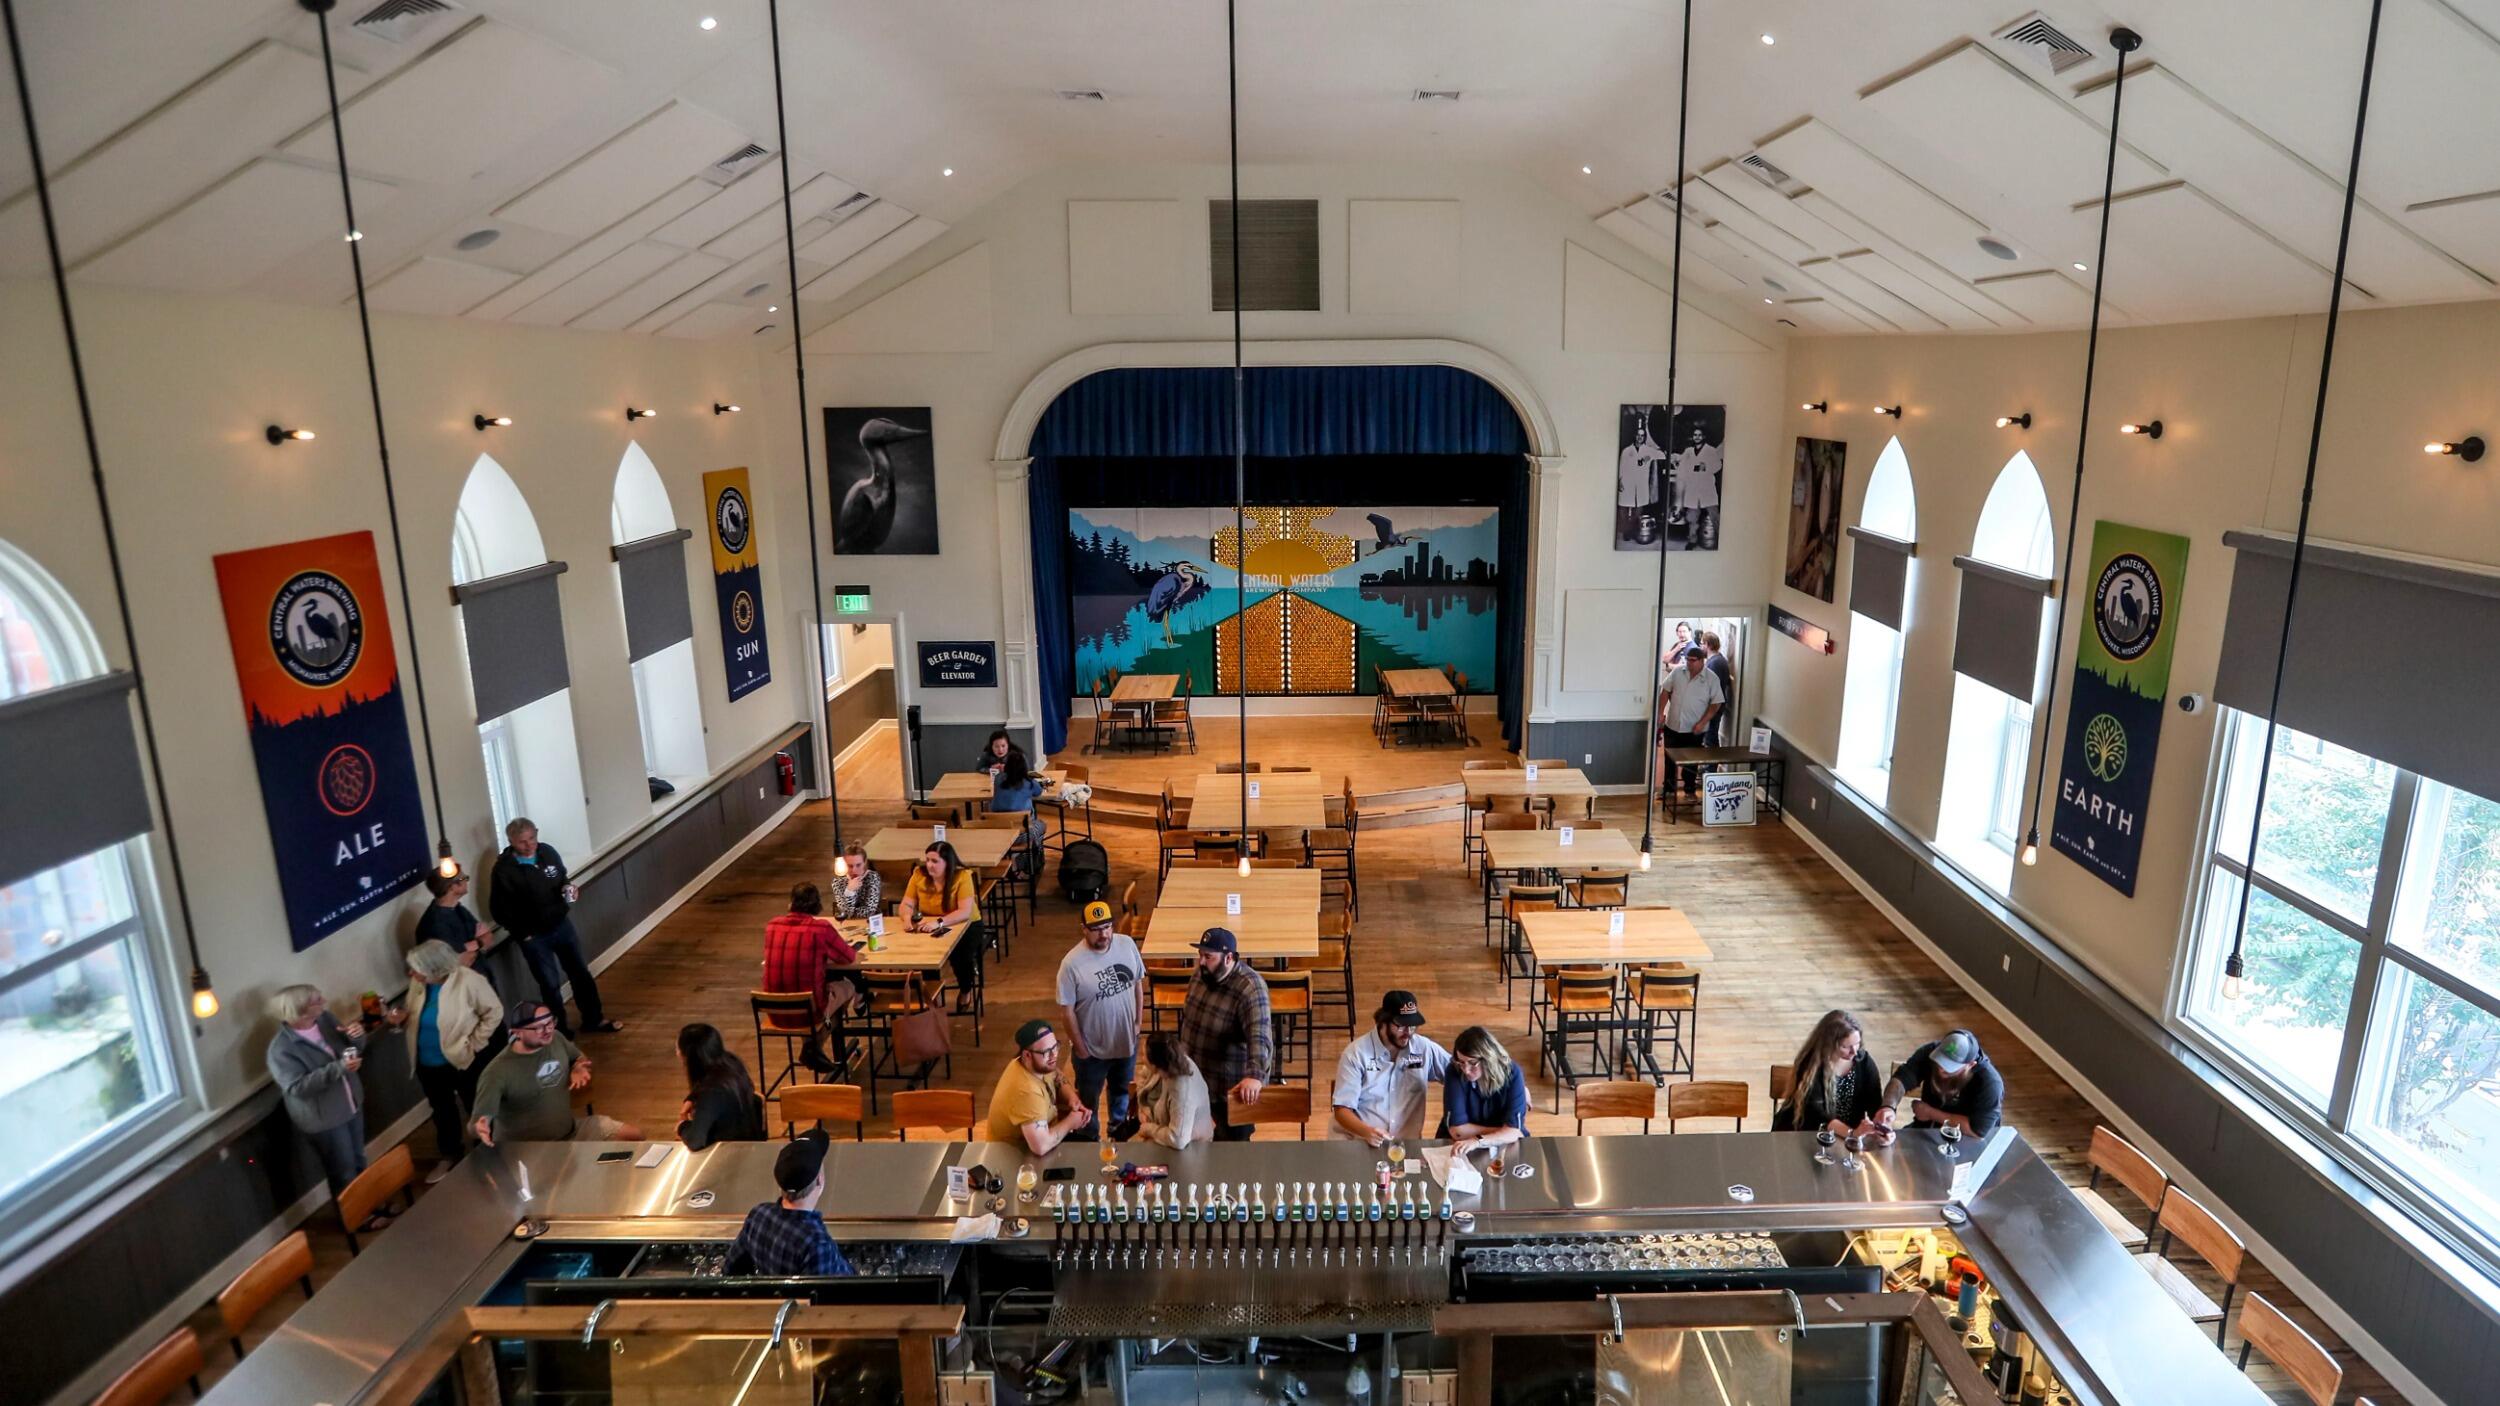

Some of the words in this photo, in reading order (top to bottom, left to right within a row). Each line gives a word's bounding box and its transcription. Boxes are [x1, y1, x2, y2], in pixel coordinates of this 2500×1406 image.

[1235, 574, 1284, 588] CENTRAL
[1289, 574, 1335, 588] WATERS
[2097, 563, 2119, 599] CENTRAL
[2119, 559, 2146, 574] WATERS
[2144, 570, 2160, 616] BREWING
[274, 591, 294, 639] CENTRAL
[290, 577, 326, 594] WATERS
[326, 581, 358, 620] BREWING
[843, 595, 864, 609] EXIT
[737, 639, 759, 661] SUN
[2121, 635, 2150, 656] WISCONSIN
[927, 651, 951, 667] BEER
[951, 650, 988, 666] GARDEN
[953, 662, 962, 670] &
[941, 672, 976, 680] ELEVATOR
[1707, 779, 1753, 795] Dairyland
[2062, 778, 2134, 836] EARTH
[334, 822, 386, 866] ALE
[359, 887, 383, 903] EARTH
[1094, 966, 1115, 981] THE
[1098, 975, 1118, 990] GAS
[1095, 984, 1121, 1001] FACE
